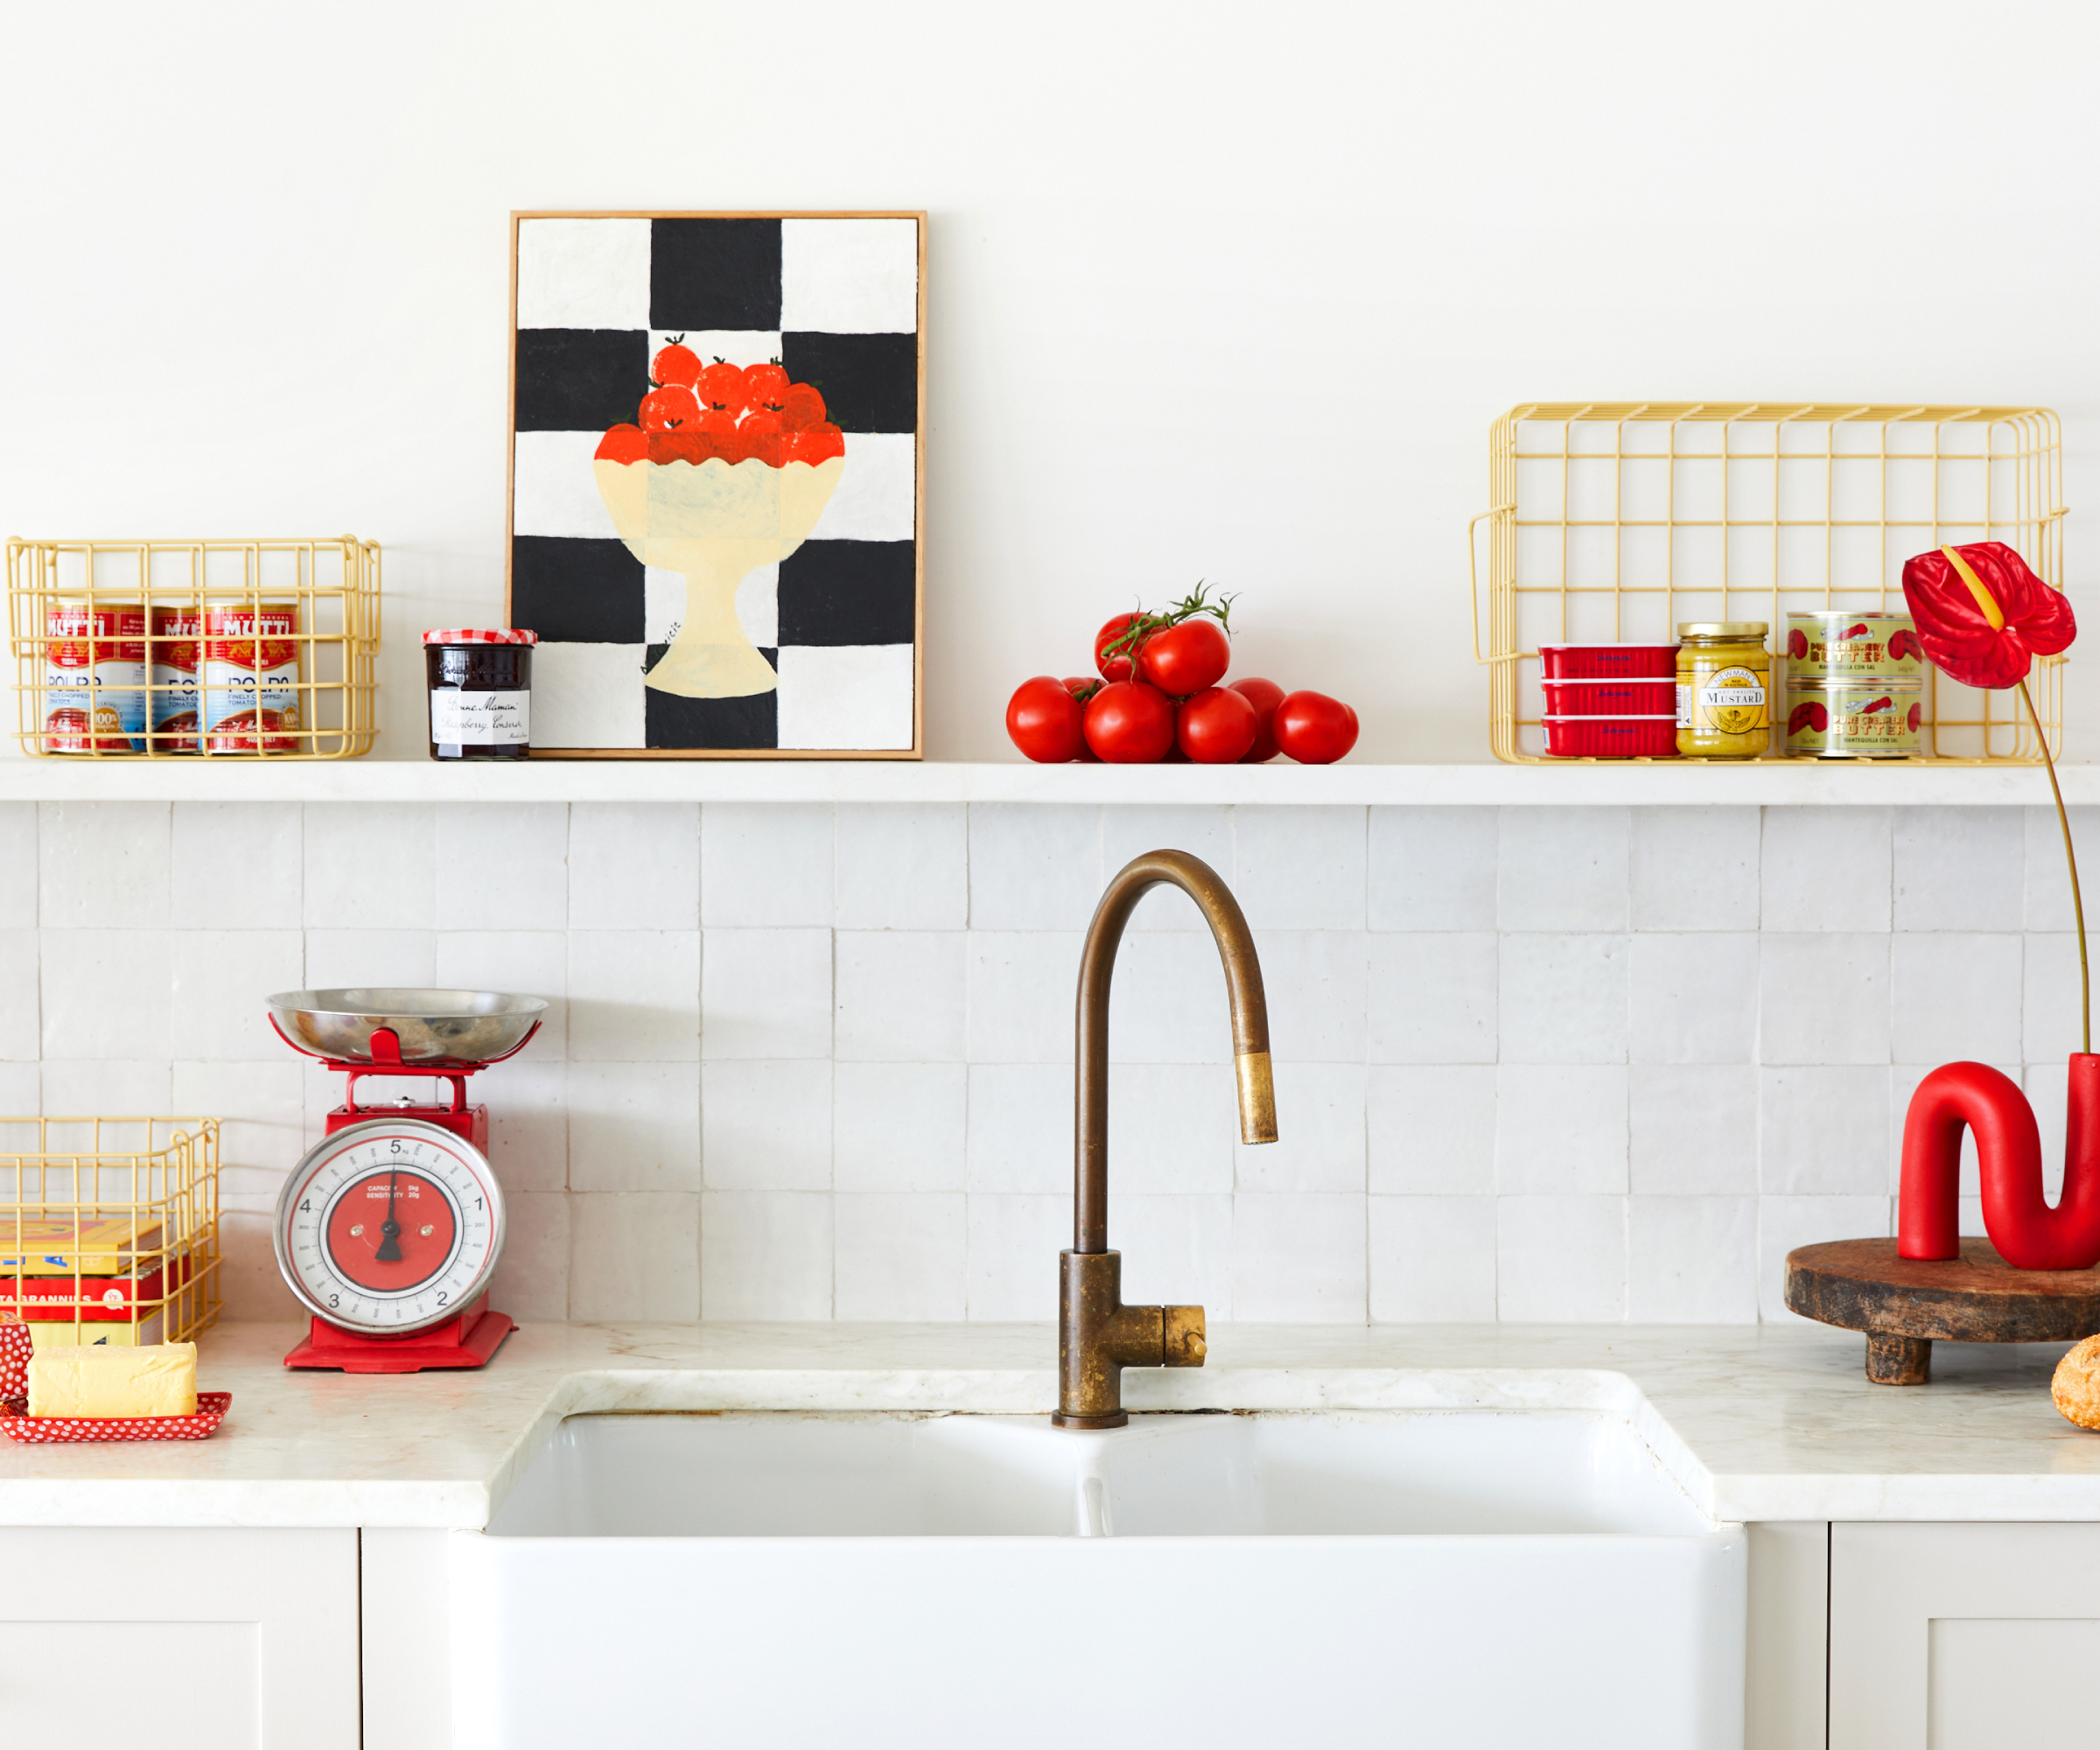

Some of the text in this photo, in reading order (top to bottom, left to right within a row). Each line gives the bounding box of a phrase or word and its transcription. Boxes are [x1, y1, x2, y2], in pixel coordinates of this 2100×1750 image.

[224, 620, 290, 637] MUTTI
[1810, 651, 1885, 662] BUTTER
[1714, 668, 1756, 685] NEWMAN'S
[168, 679, 198, 695] PO
[1832, 716, 1906, 724] PURE CREAMERY
[1832, 724, 1906, 736] BUTTER
[391, 1139, 402, 1154] 5
[299, 1199, 312, 1214] 4
[474, 1196, 482, 1211] 1
[329, 1293, 340, 1308] 3
[437, 1291, 447, 1306] 2
